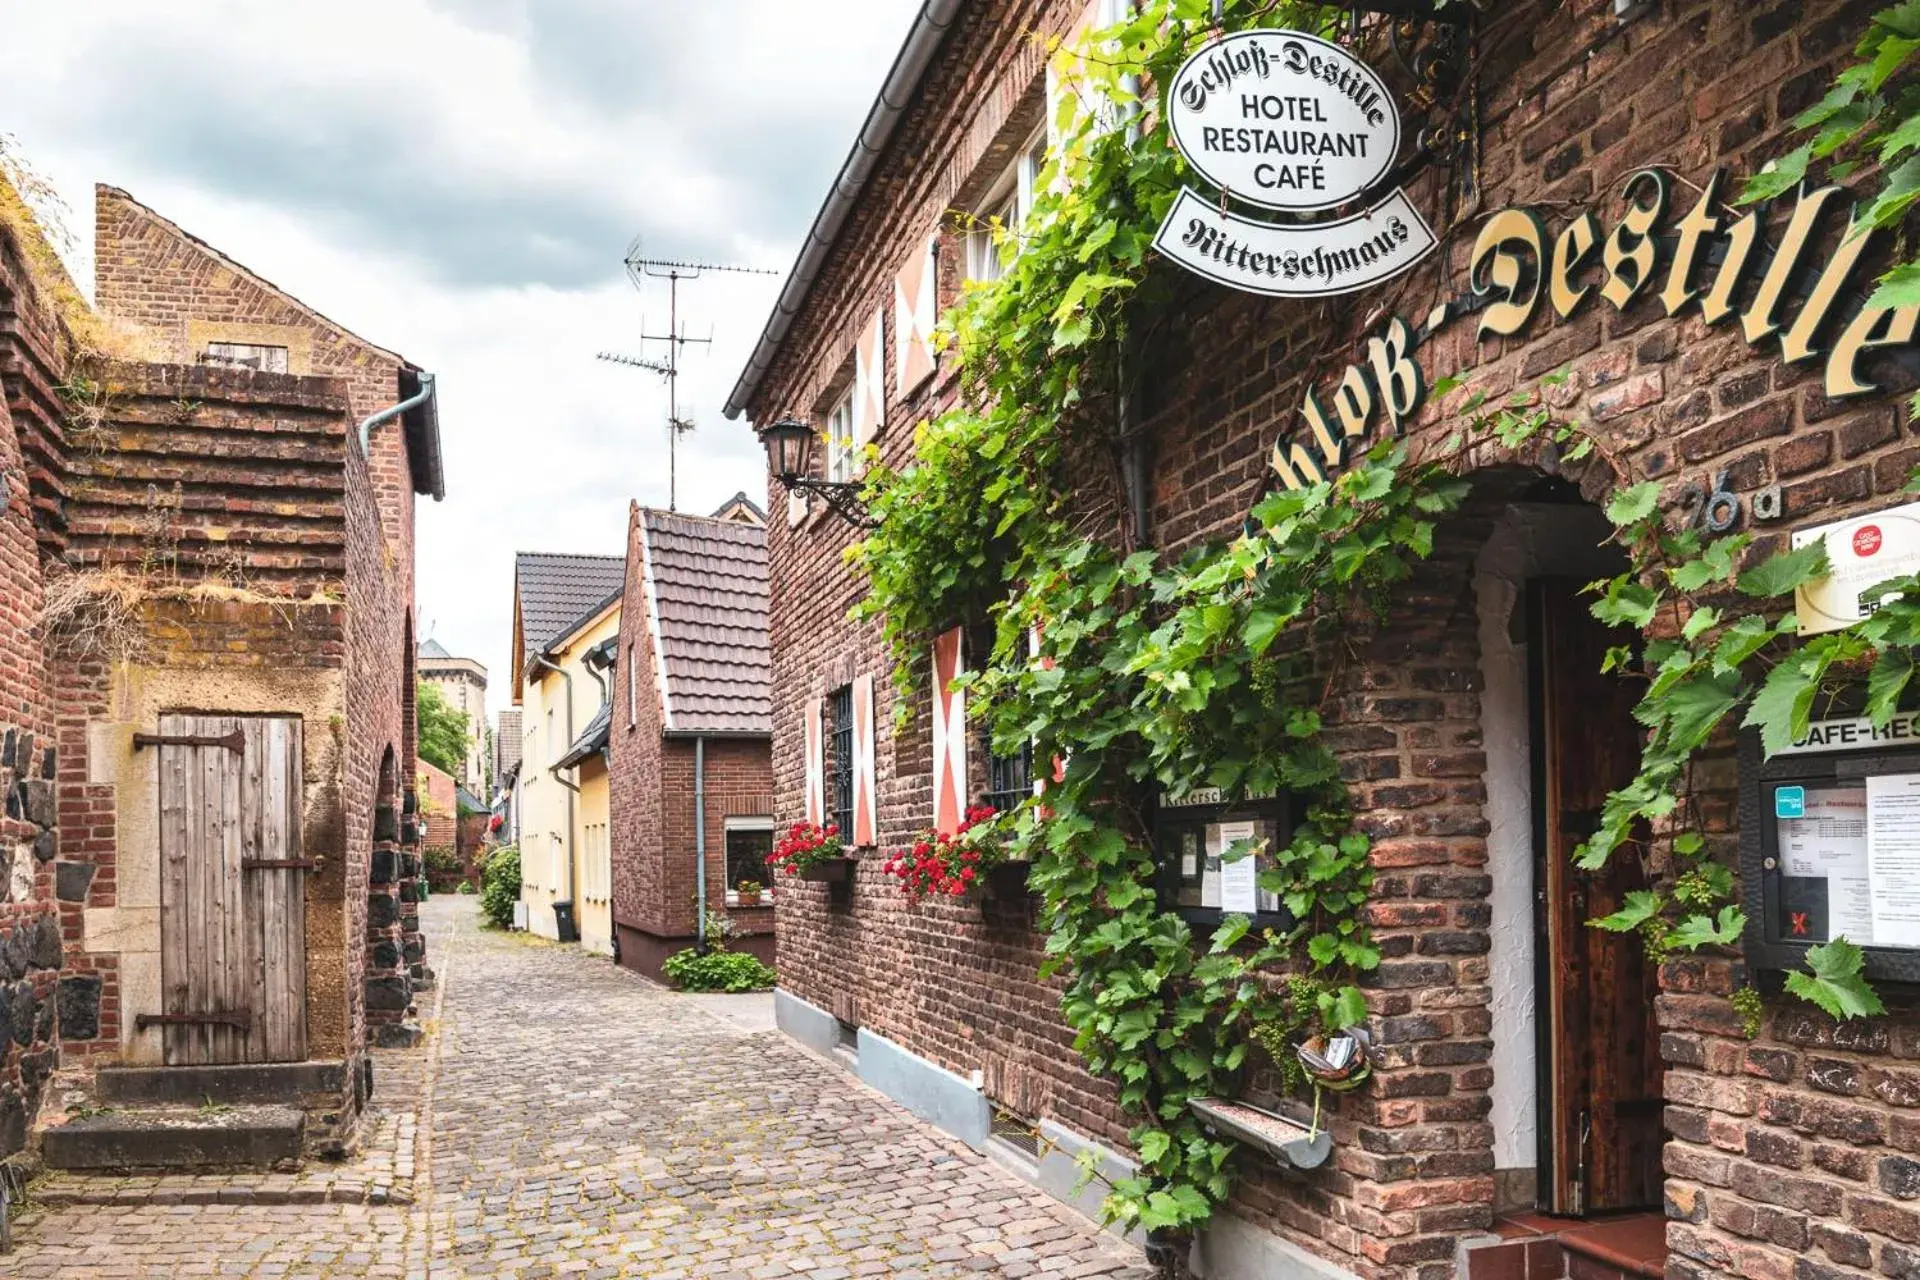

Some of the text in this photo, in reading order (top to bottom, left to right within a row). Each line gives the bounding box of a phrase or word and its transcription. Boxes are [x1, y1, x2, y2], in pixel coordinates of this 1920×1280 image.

[1180, 40, 1386, 128] Schloß-Destille
[1241, 94, 1328, 123] HOTEL
[1203, 126, 1369, 158] RESTAURANT
[1254, 158, 1326, 190] CAFÉ
[1181, 216, 1409, 284] Ritterschmaus
